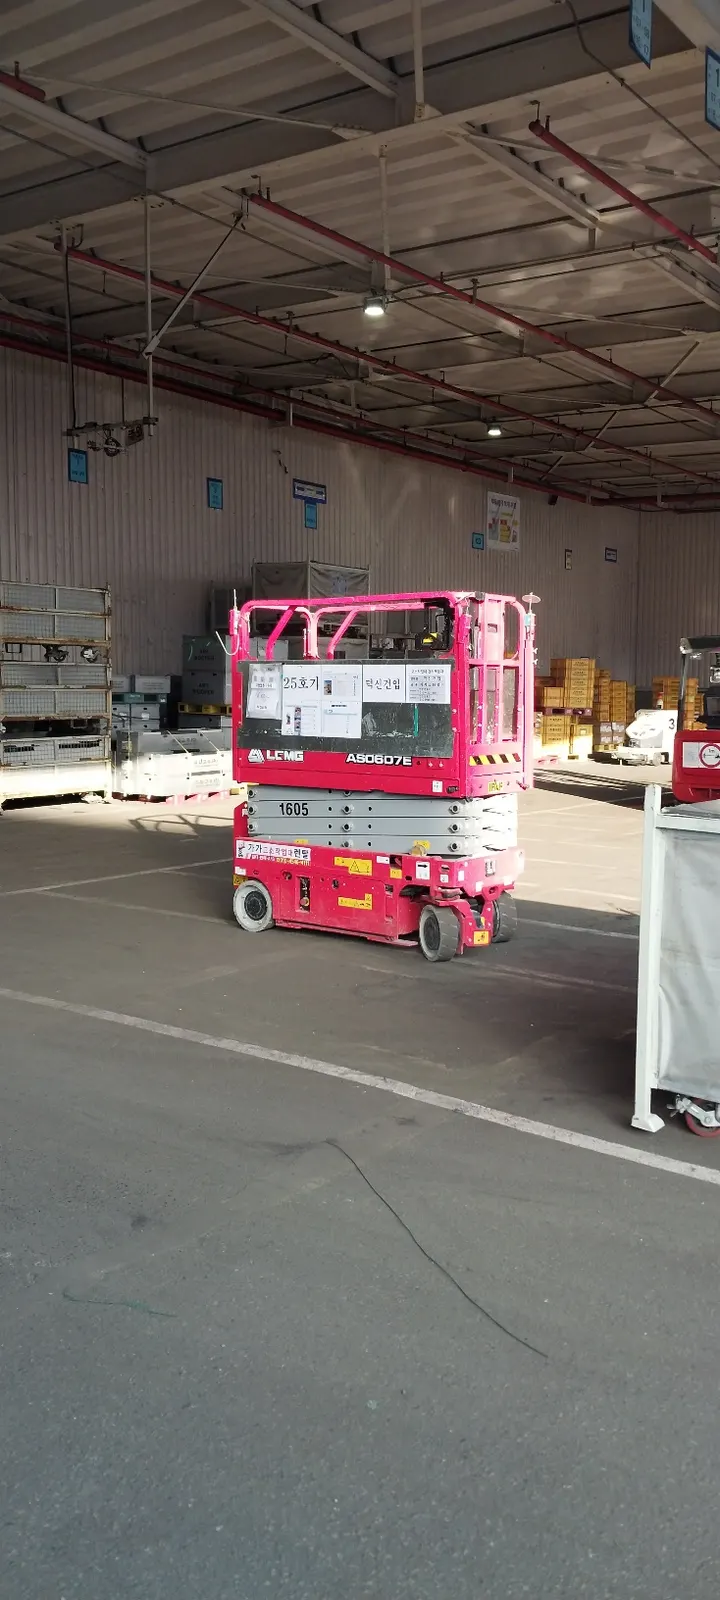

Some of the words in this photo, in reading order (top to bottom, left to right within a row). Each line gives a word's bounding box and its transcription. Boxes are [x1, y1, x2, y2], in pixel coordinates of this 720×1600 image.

[283, 675, 320, 691] 25호기
[668, 717, 676, 730] 3
[345, 753, 413, 766] AS0607E
[279, 802, 309, 817] 1605
